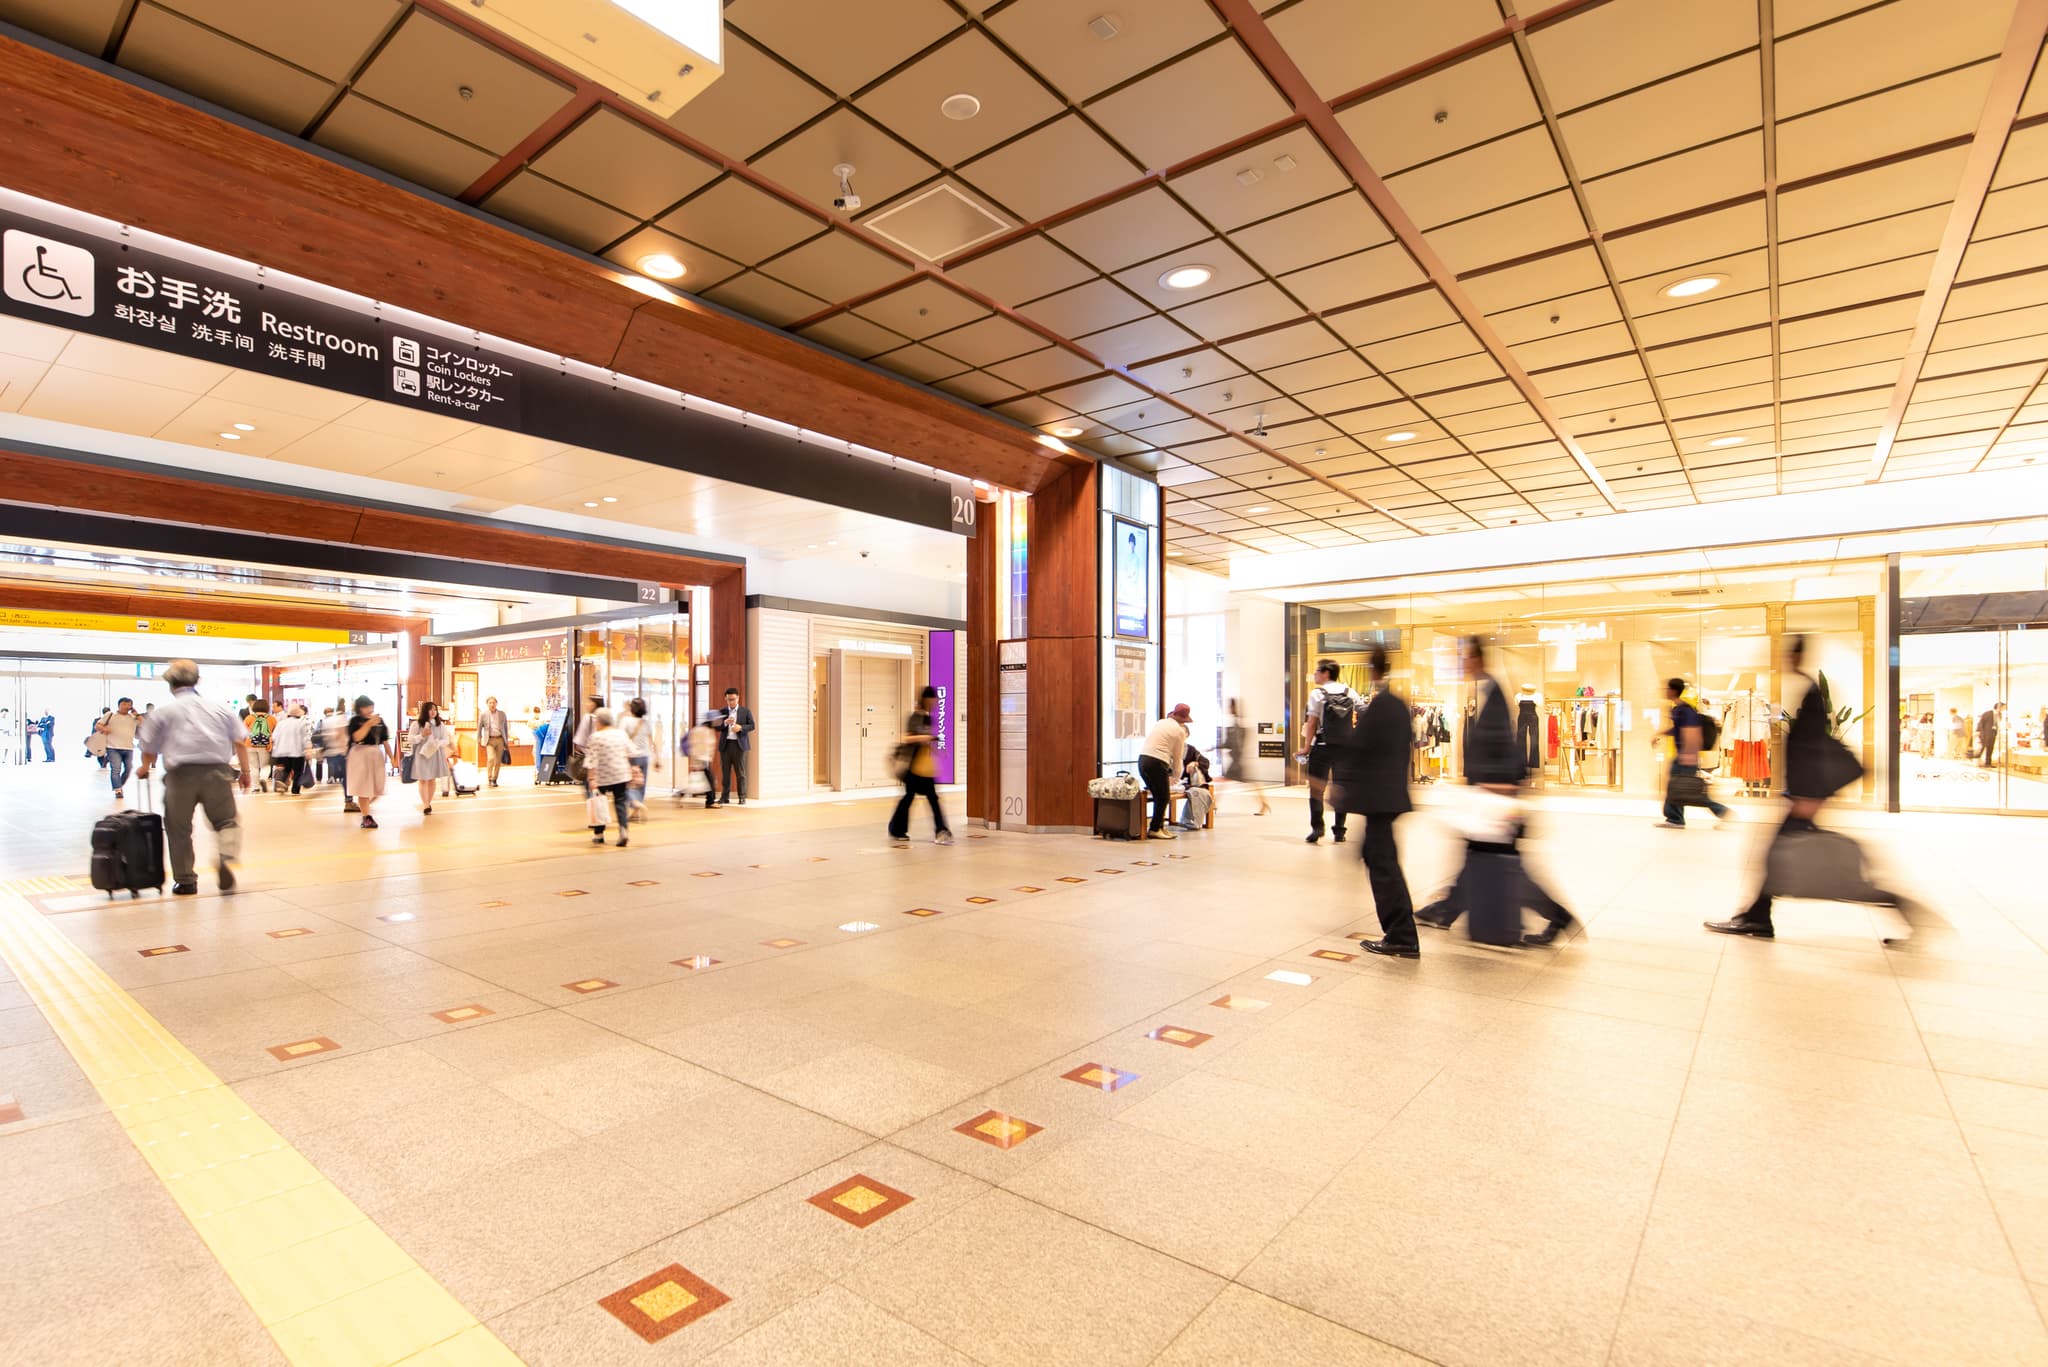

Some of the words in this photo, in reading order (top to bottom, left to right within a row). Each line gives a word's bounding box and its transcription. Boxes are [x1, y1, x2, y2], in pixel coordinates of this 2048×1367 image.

[116, 265, 242, 325] お手洗
[114, 303, 177, 334] 화장실
[191, 321, 255, 352] 洗手间
[261, 311, 379, 361] Restroom
[268, 341, 326, 370] 洗手間
[426, 346, 514, 377] コインロッカー
[426, 361, 451, 376] Coin
[454, 368, 491, 387] Lockers
[426, 374, 504, 403] 駅レンタカー
[427, 390, 481, 412] Rent-a-car
[952, 495, 975, 526] 20
[641, 587, 656, 601] 22
[351, 634, 365, 643] 24
[1004, 796, 1024, 817] 20
